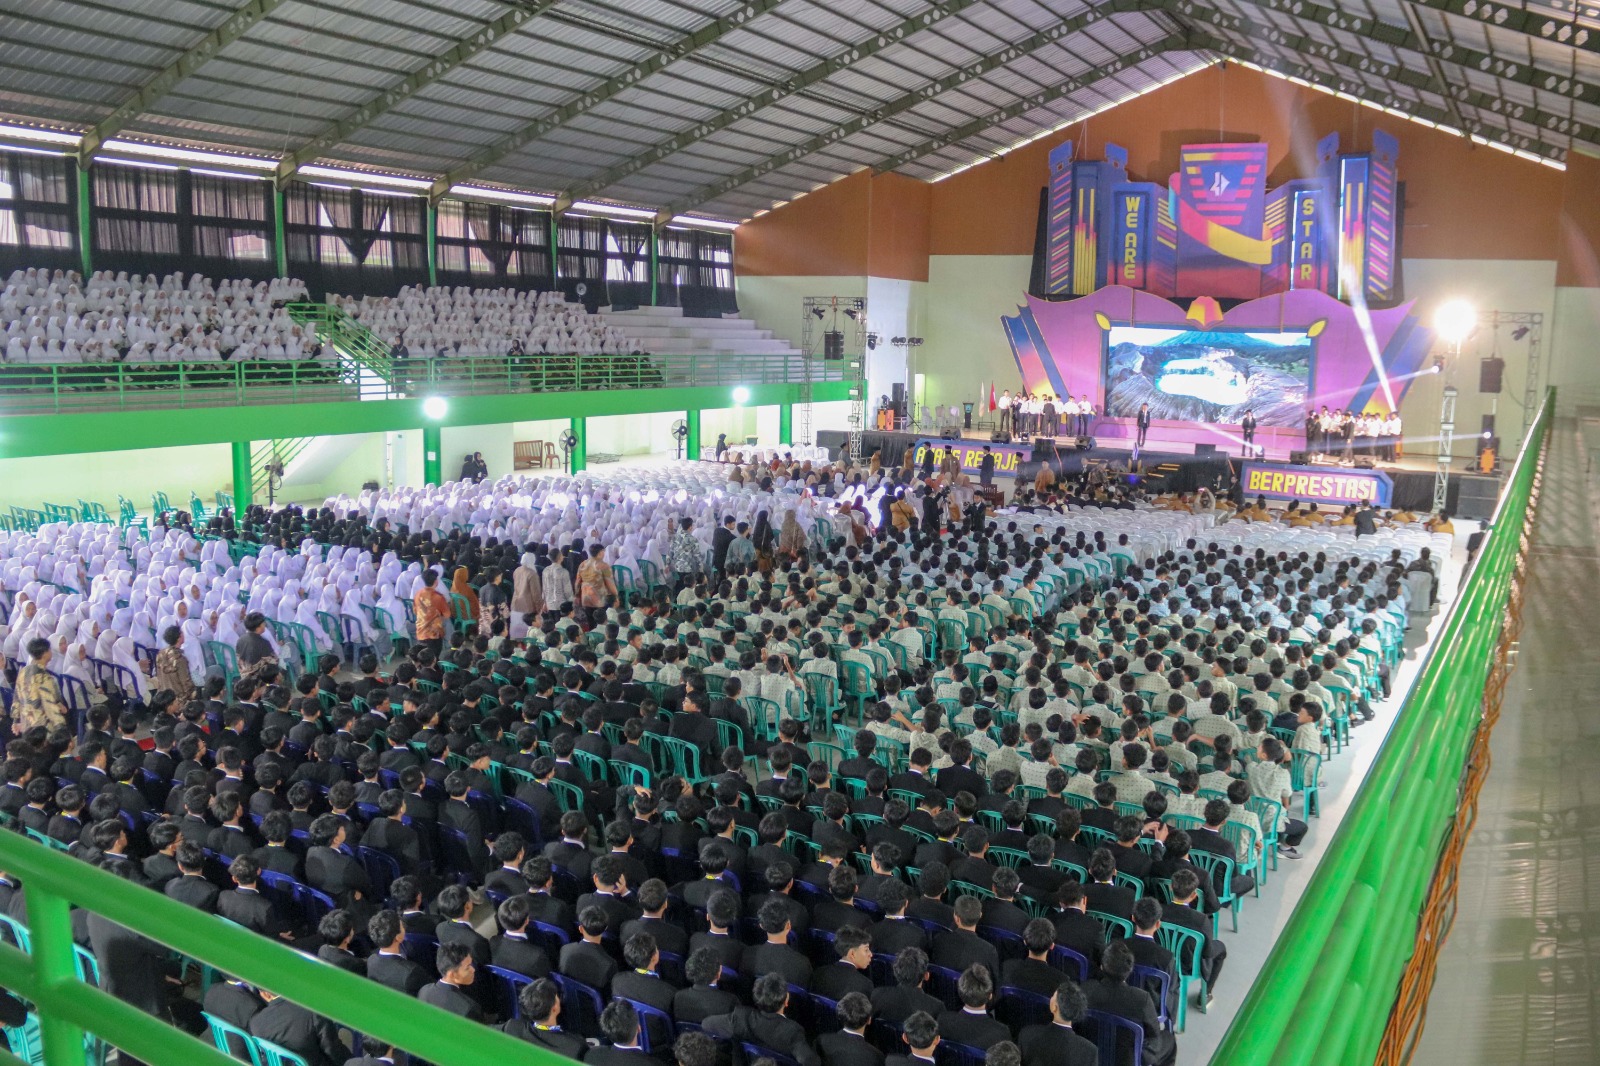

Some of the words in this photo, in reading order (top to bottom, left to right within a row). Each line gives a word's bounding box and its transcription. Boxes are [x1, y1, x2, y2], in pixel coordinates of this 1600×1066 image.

[1125, 196, 1141, 228] WE
[1124, 233, 1137, 280] ARE
[1300, 198, 1315, 281] STAR
[1249, 470, 1378, 500] BERPRESTASI
